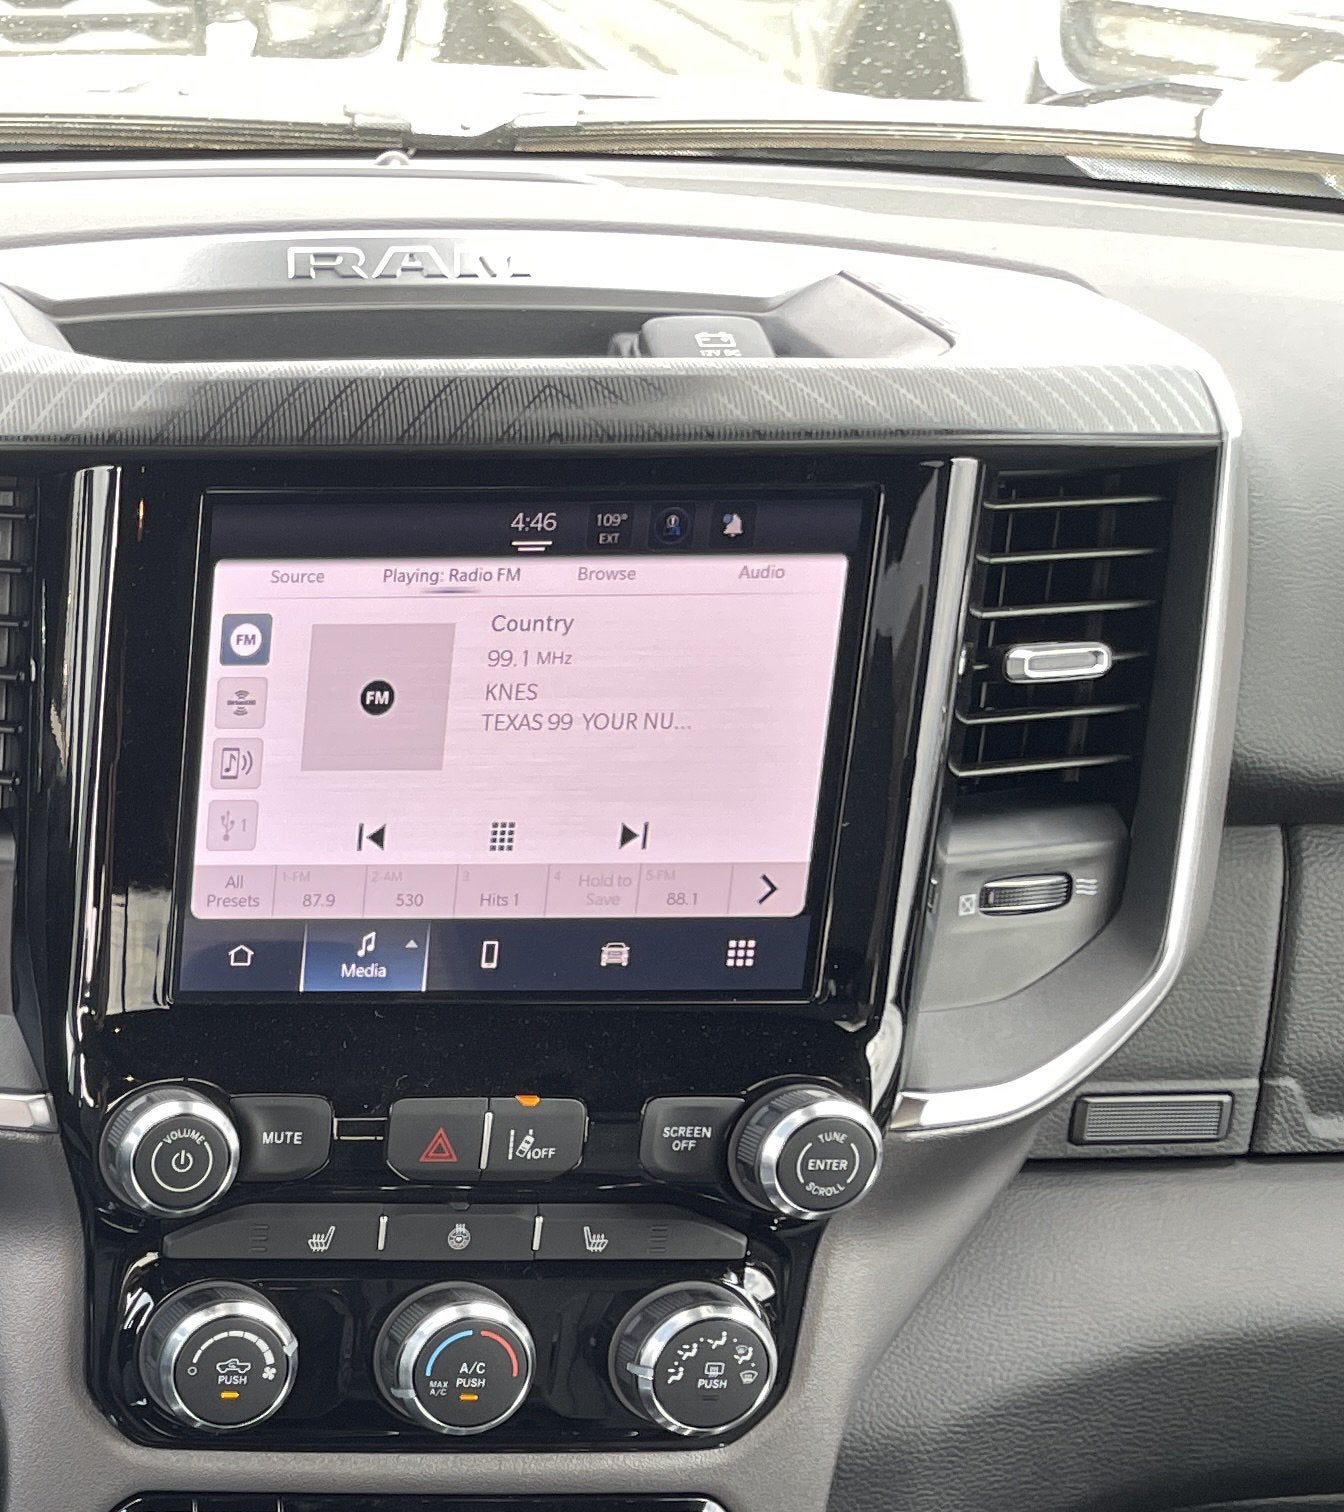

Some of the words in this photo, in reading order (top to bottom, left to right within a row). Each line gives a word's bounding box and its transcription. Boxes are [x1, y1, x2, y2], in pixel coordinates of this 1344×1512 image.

[288, 244, 531, 279] RAM
[511, 512, 558, 532] 4:46
[599, 533, 620, 544] EXT
[270, 569, 325, 584] Source
[383, 568, 445, 586] Playing:
[448, 568, 493, 582] Radio
[496, 567, 522, 582] FM
[577, 566, 637, 581] Browse
[738, 565, 786, 580] Audio
[491, 614, 575, 636] Country
[236, 635, 256, 646] FM
[487, 650, 529, 668] 99.1
[536, 651, 573, 666] MHz
[365, 690, 390, 705] FM
[485, 683, 538, 701] KNES
[481, 714, 543, 731] TEXAS
[548, 714, 573, 730] 99
[582, 713, 638, 730] YOUR
[225, 875, 244, 889] All
[578, 874, 615, 888] Hold
[617, 875, 632, 888] to
[206, 894, 260, 907] Presets
[302, 894, 336, 907] 87.9
[396, 894, 424, 907] 530
[479, 893, 509, 907] Hits
[514, 893, 520, 906] 1
[586, 893, 621, 906] Save
[666, 892, 698, 906] 88.1
[341, 963, 387, 978] Media
[163, 1128, 207, 1146] VOLUME
[262, 1131, 303, 1145] MUTE
[662, 1126, 712, 1138] SCREEN
[817, 1131, 848, 1144] TUNE
[672, 1140, 697, 1152] OFF
[531, 1147, 556, 1160] OFF
[807, 1159, 849, 1172] ENTER
[805, 1181, 846, 1197] SCROLL
[459, 1361, 486, 1375] A/C
[218, 1374, 248, 1386] PUSH
[429, 1380, 449, 1388] MAX
[455, 1377, 486, 1388] PUSH
[697, 1379, 728, 1389] PUSH
[429, 1388, 448, 1397] A/C
